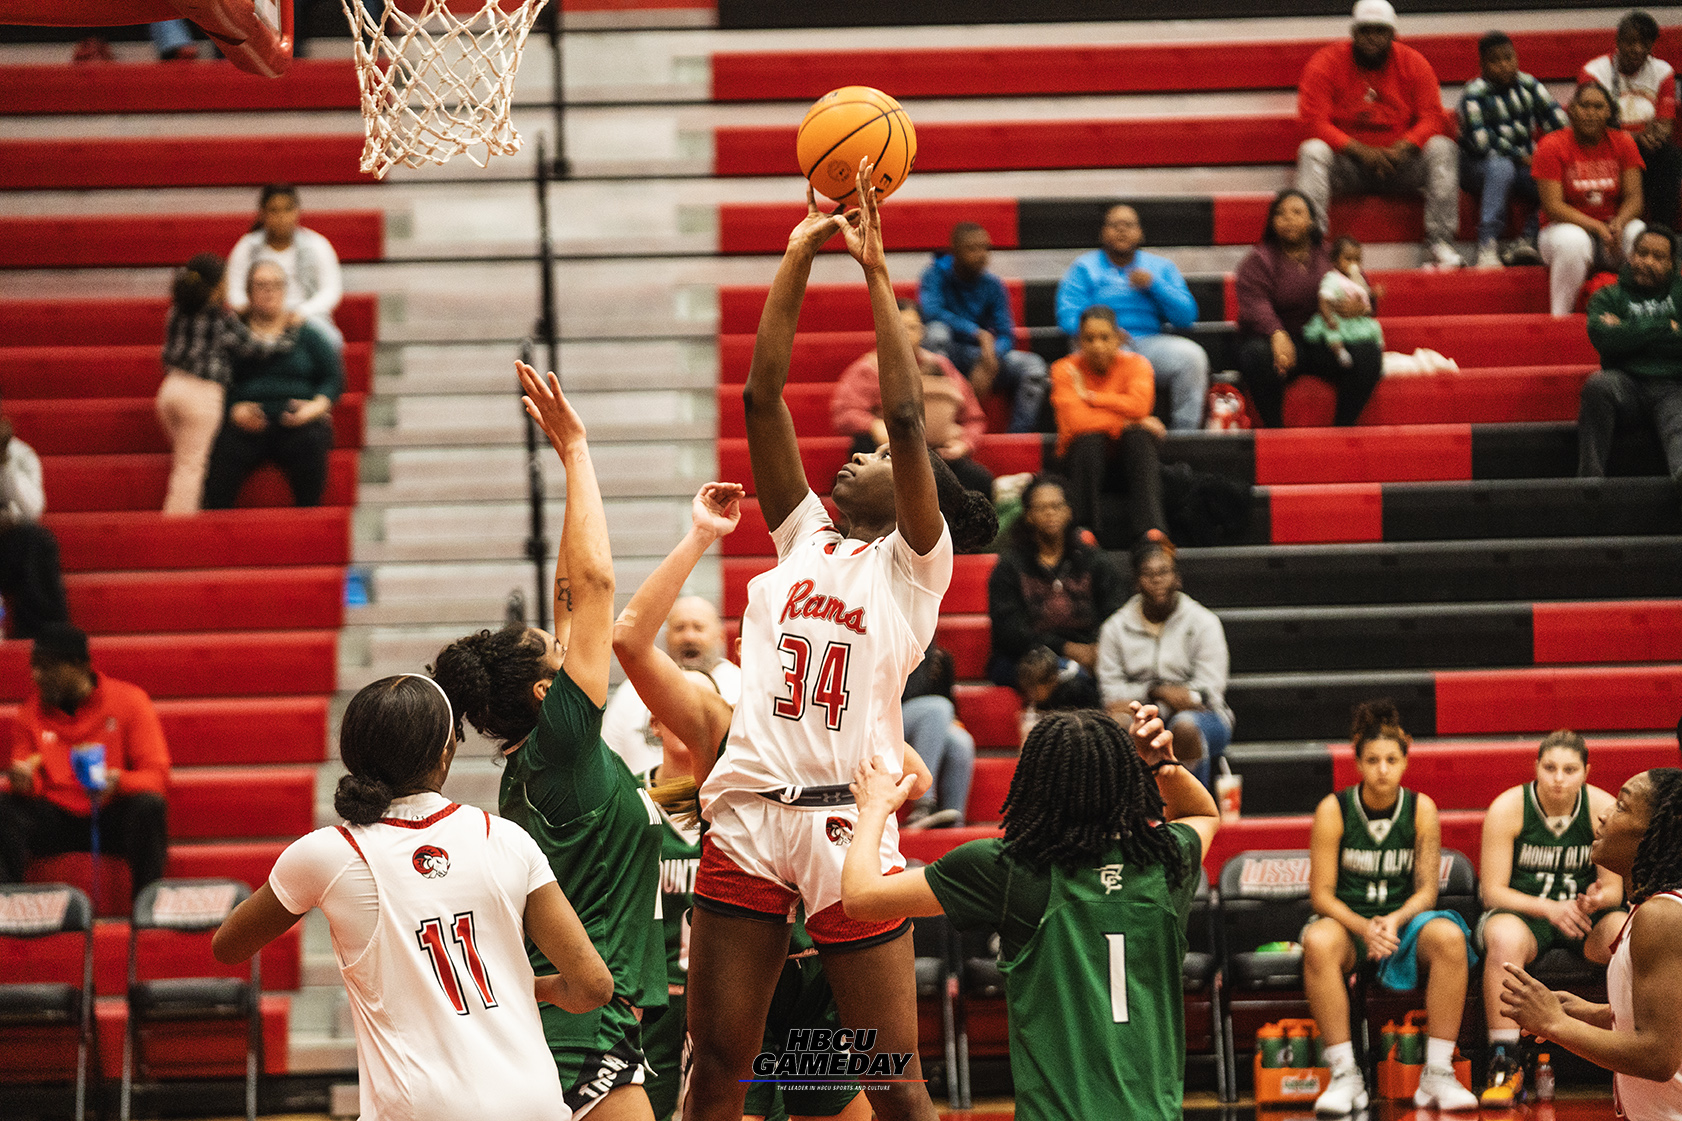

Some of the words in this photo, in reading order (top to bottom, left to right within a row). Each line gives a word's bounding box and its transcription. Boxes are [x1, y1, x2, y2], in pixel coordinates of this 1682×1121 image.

[778, 578, 867, 635] Rams
[773, 632, 852, 731] 34
[1518, 843, 1563, 870] MOUNT
[1564, 845, 1594, 870] OLIV
[415, 911, 499, 1015] 11
[1102, 932, 1130, 1024] 1
